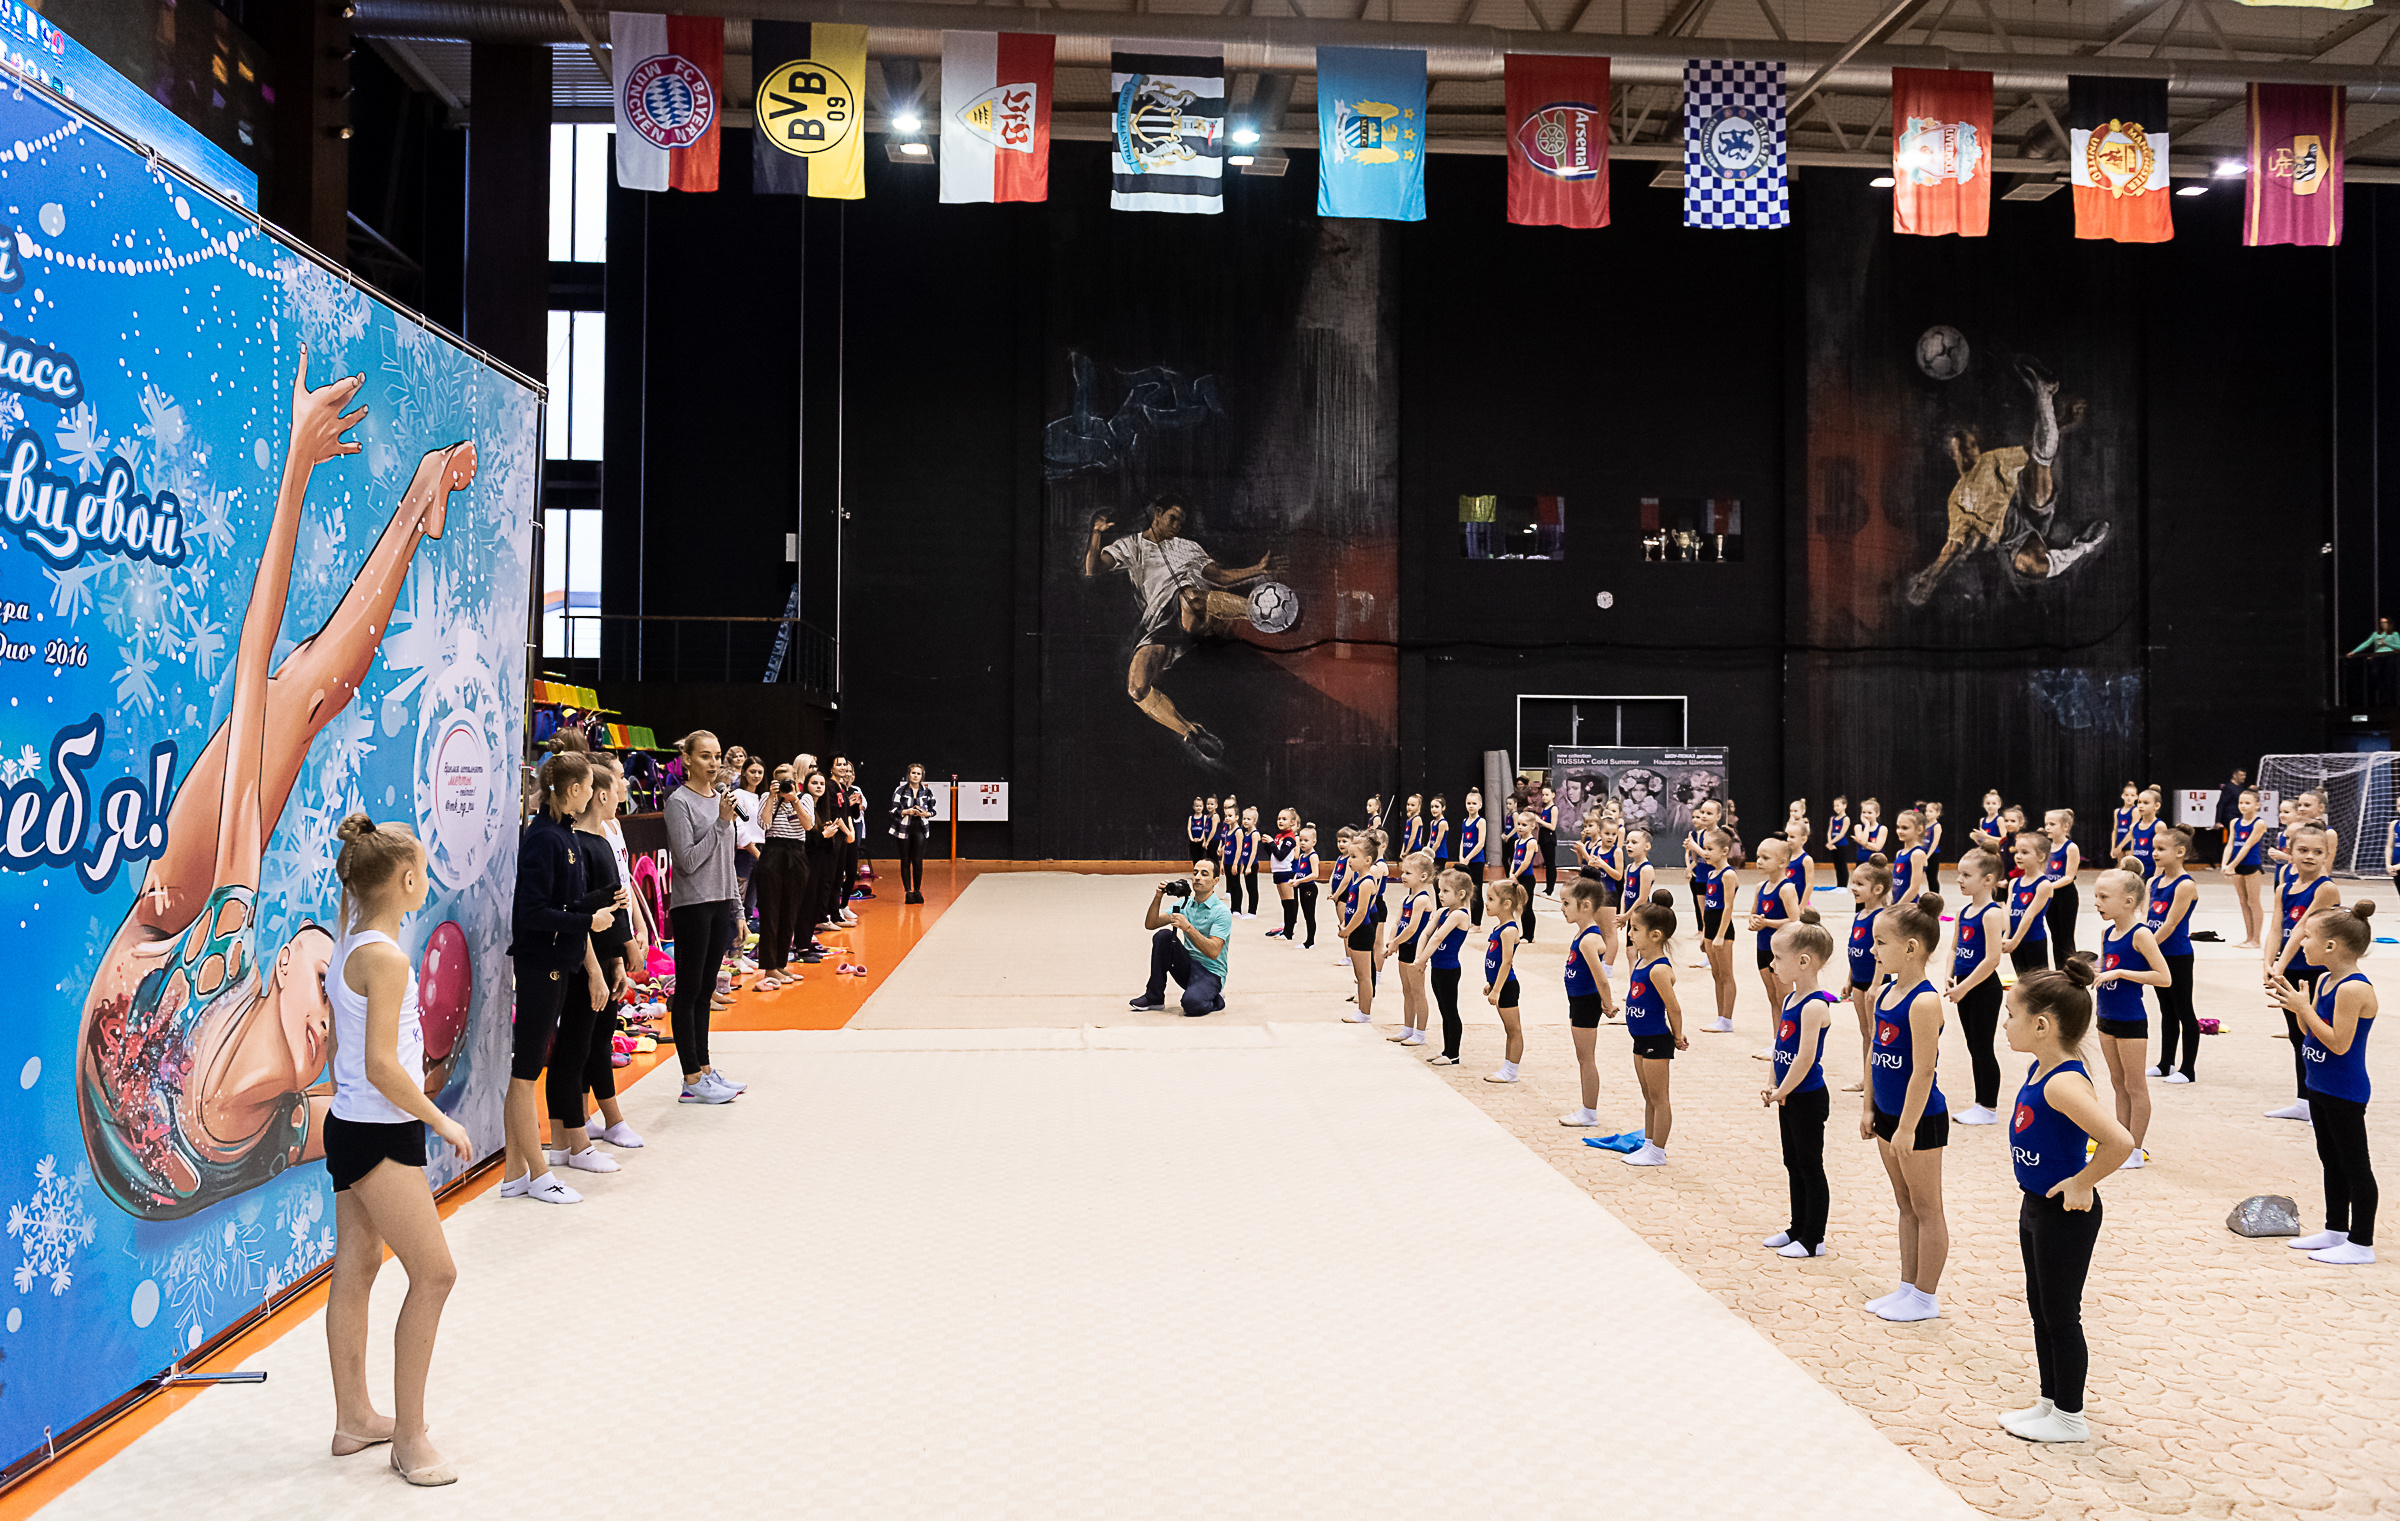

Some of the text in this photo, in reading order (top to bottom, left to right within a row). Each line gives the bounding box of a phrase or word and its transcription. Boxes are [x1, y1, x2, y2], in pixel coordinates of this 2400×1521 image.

[674, 61, 708, 142] FC BAYERN
[769, 71, 826, 141] BVB
[827, 97, 846, 121] 09
[1575, 111, 1589, 171] Arsenal
[1754, 120, 1769, 168] CHELSEA
[0, 439, 181, 560] вцевой
[45, 641, 88, 667] 2016
[0, 726, 172, 882] ебя!
